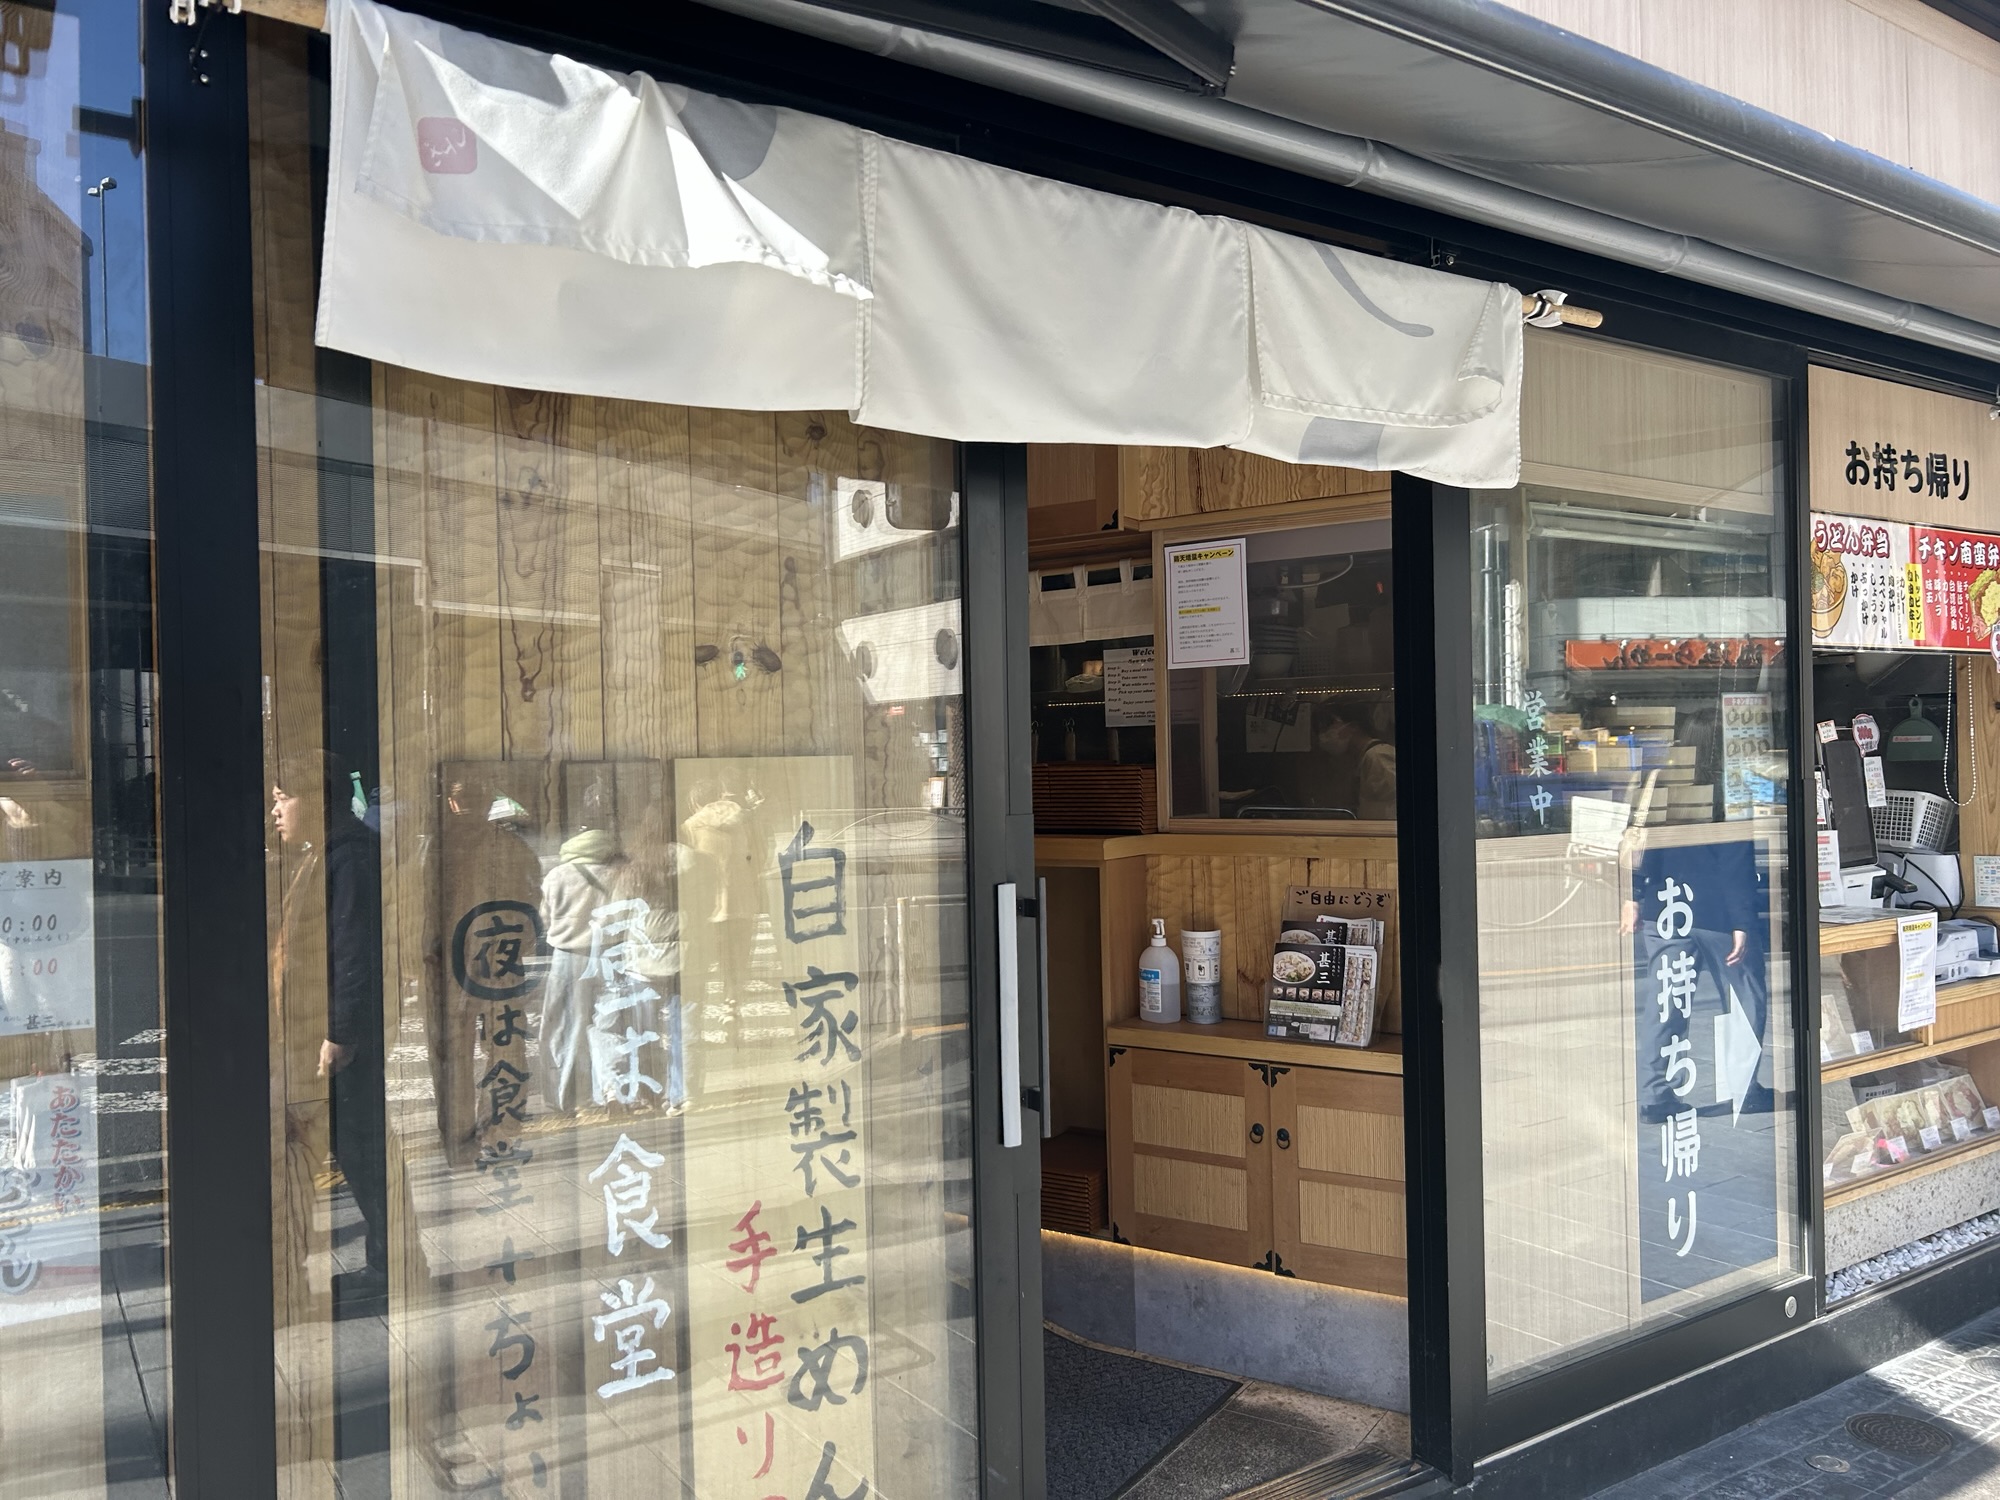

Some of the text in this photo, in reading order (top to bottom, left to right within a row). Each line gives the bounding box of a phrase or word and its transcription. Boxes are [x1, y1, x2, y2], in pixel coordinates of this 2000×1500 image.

[1845, 440, 1970, 501] お持ち帰り
[1814, 520, 1891, 558] うどん弁当
[1851, 571, 1860, 599] かけ
[1870, 572, 1879, 626] しょうゆ
[1878, 574, 1888, 640] スペシャル
[1913, 570, 1922, 635] トッピング
[1963, 580, 1971, 647] チャーシュー
[1520, 690, 1555, 826] 営業中
[1295, 890, 1391, 908] ご自由にどうぞ
[1316, 951, 1332, 984] 甚三
[1656, 877, 1701, 1258] お持ち帰り
[49, 1085, 85, 1214] あたたかい
[578, 897, 676, 1399] 昼は食堂
[779, 820, 870, 1500] 自家製生めん
[725, 1199, 787, 1500] 手造り
